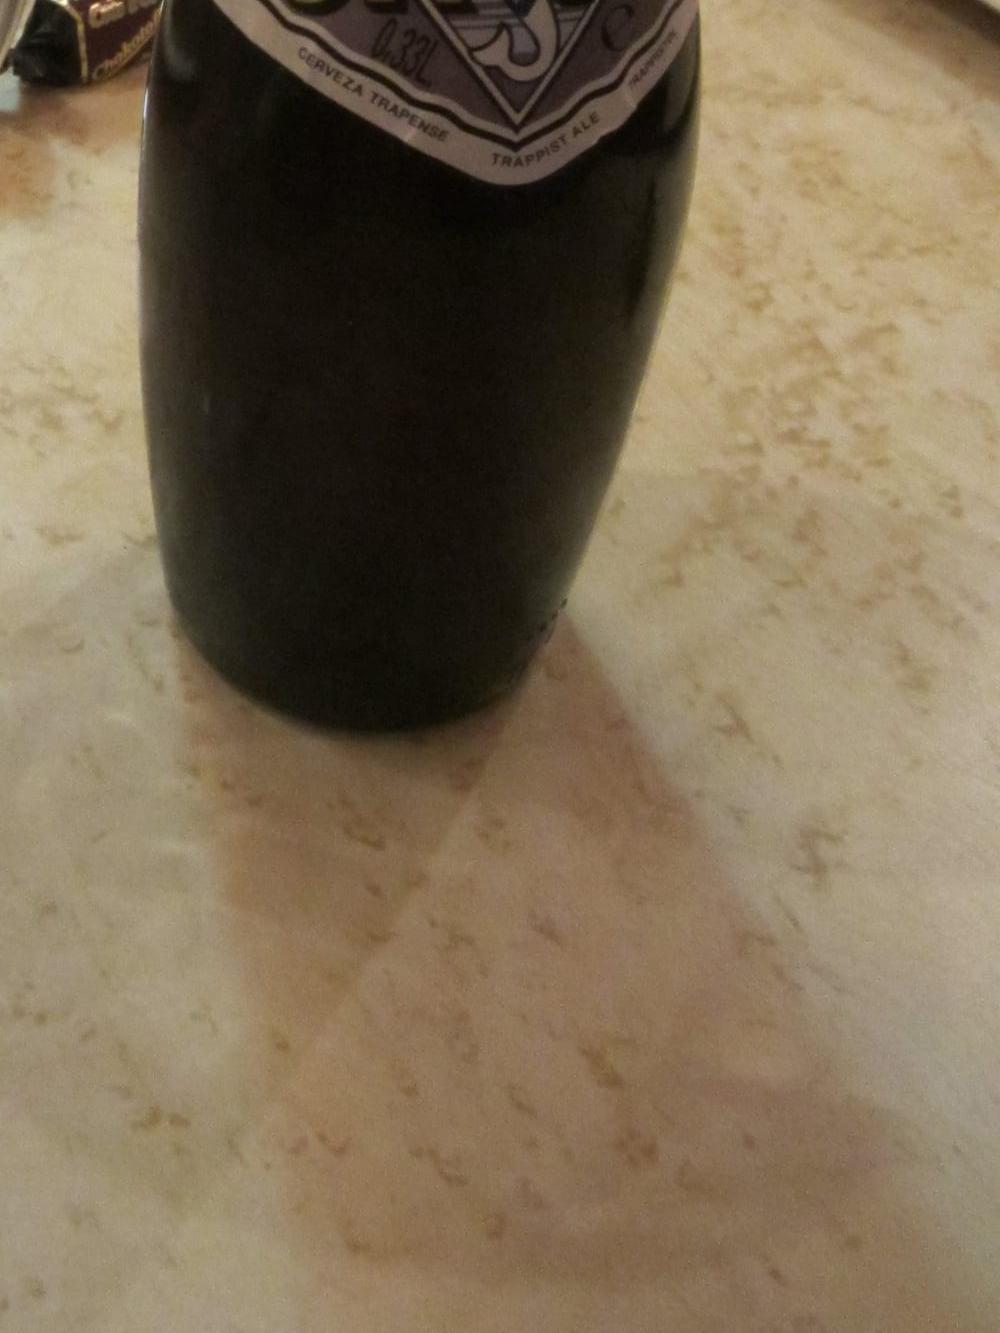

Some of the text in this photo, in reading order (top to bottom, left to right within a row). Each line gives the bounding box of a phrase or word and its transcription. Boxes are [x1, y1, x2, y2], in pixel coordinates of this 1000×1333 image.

[298, 46, 450, 142] CERVEZA TRAPENSE
[492, 111, 601, 169] TRAPPIST ALE
